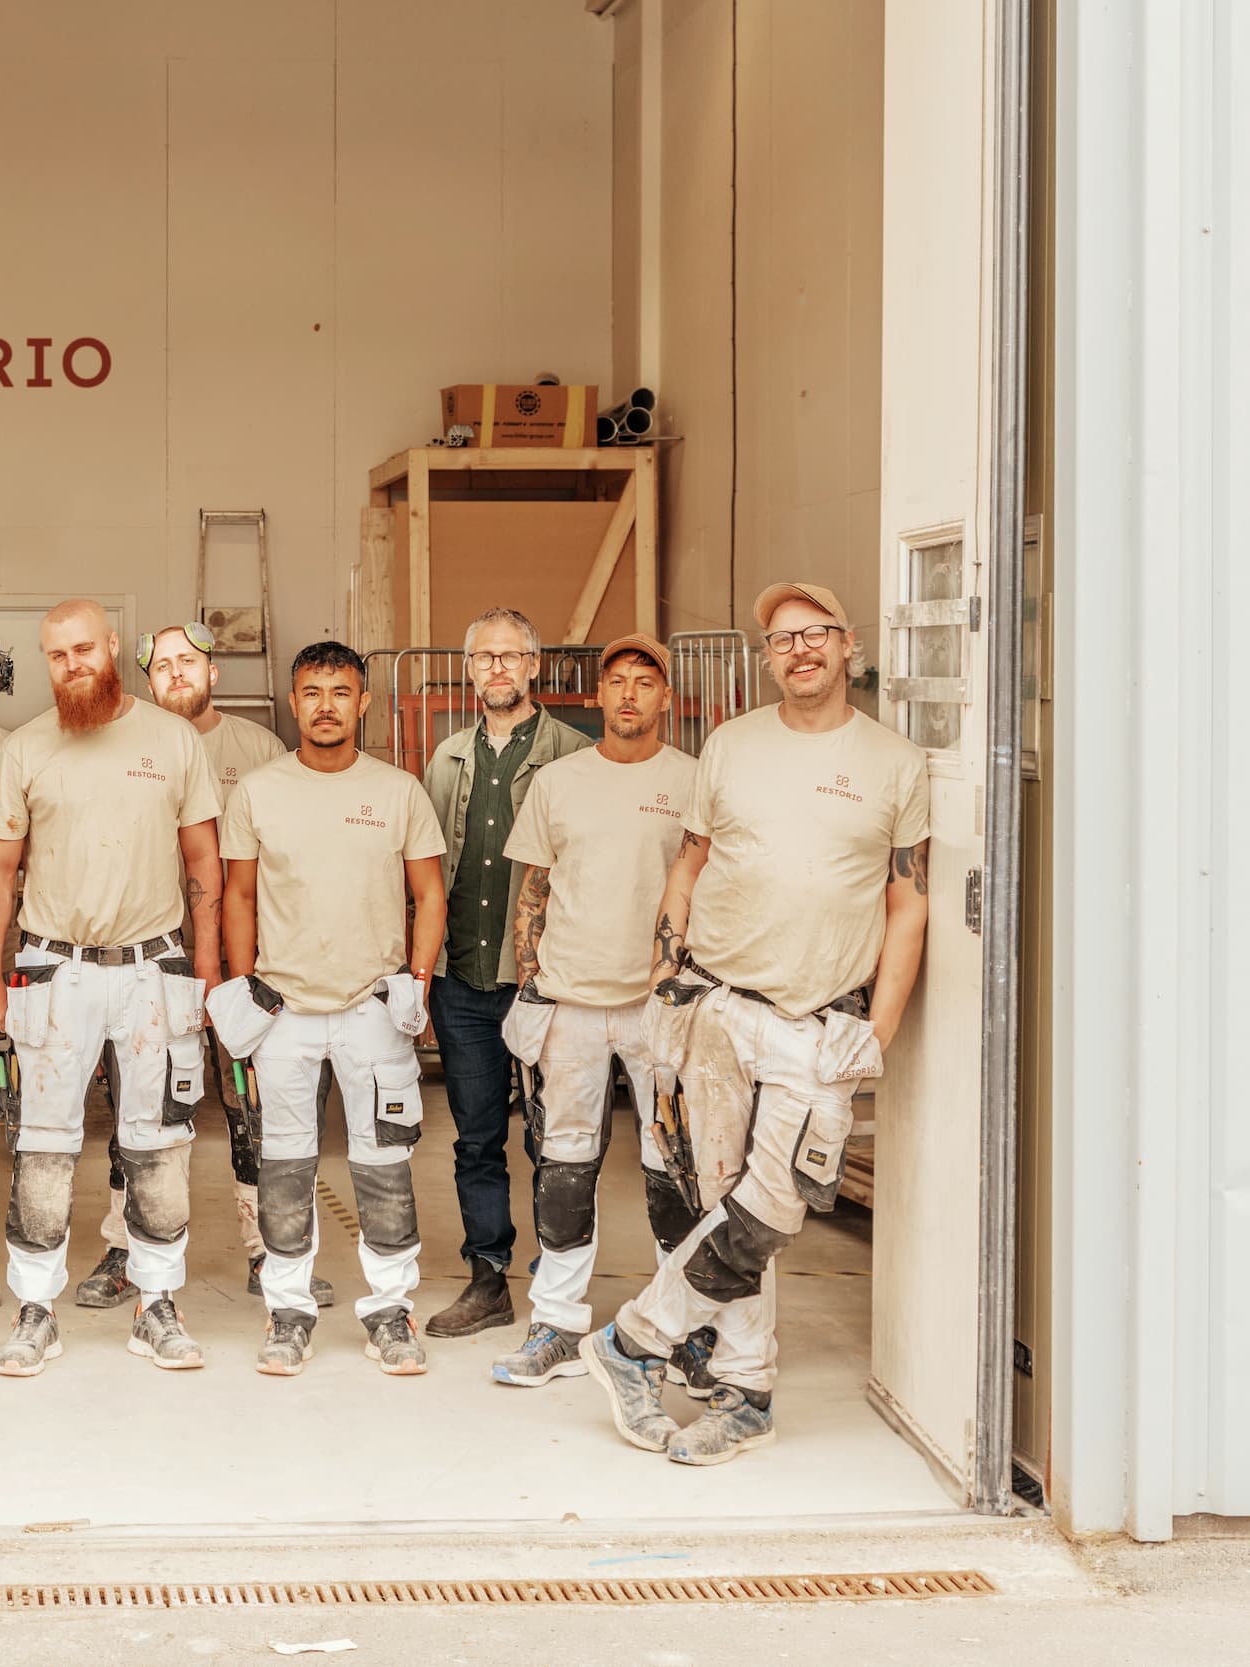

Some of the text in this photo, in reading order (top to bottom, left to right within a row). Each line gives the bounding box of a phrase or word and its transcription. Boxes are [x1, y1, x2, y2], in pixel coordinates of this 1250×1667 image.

[127, 770, 166, 782] RESTORIO
[816, 786, 863, 803] RESTORIO
[639, 805, 682, 819] RESTORIO
[345, 817, 387, 828] RESTORIO
[836, 1065, 877, 1080] RESTORIO
